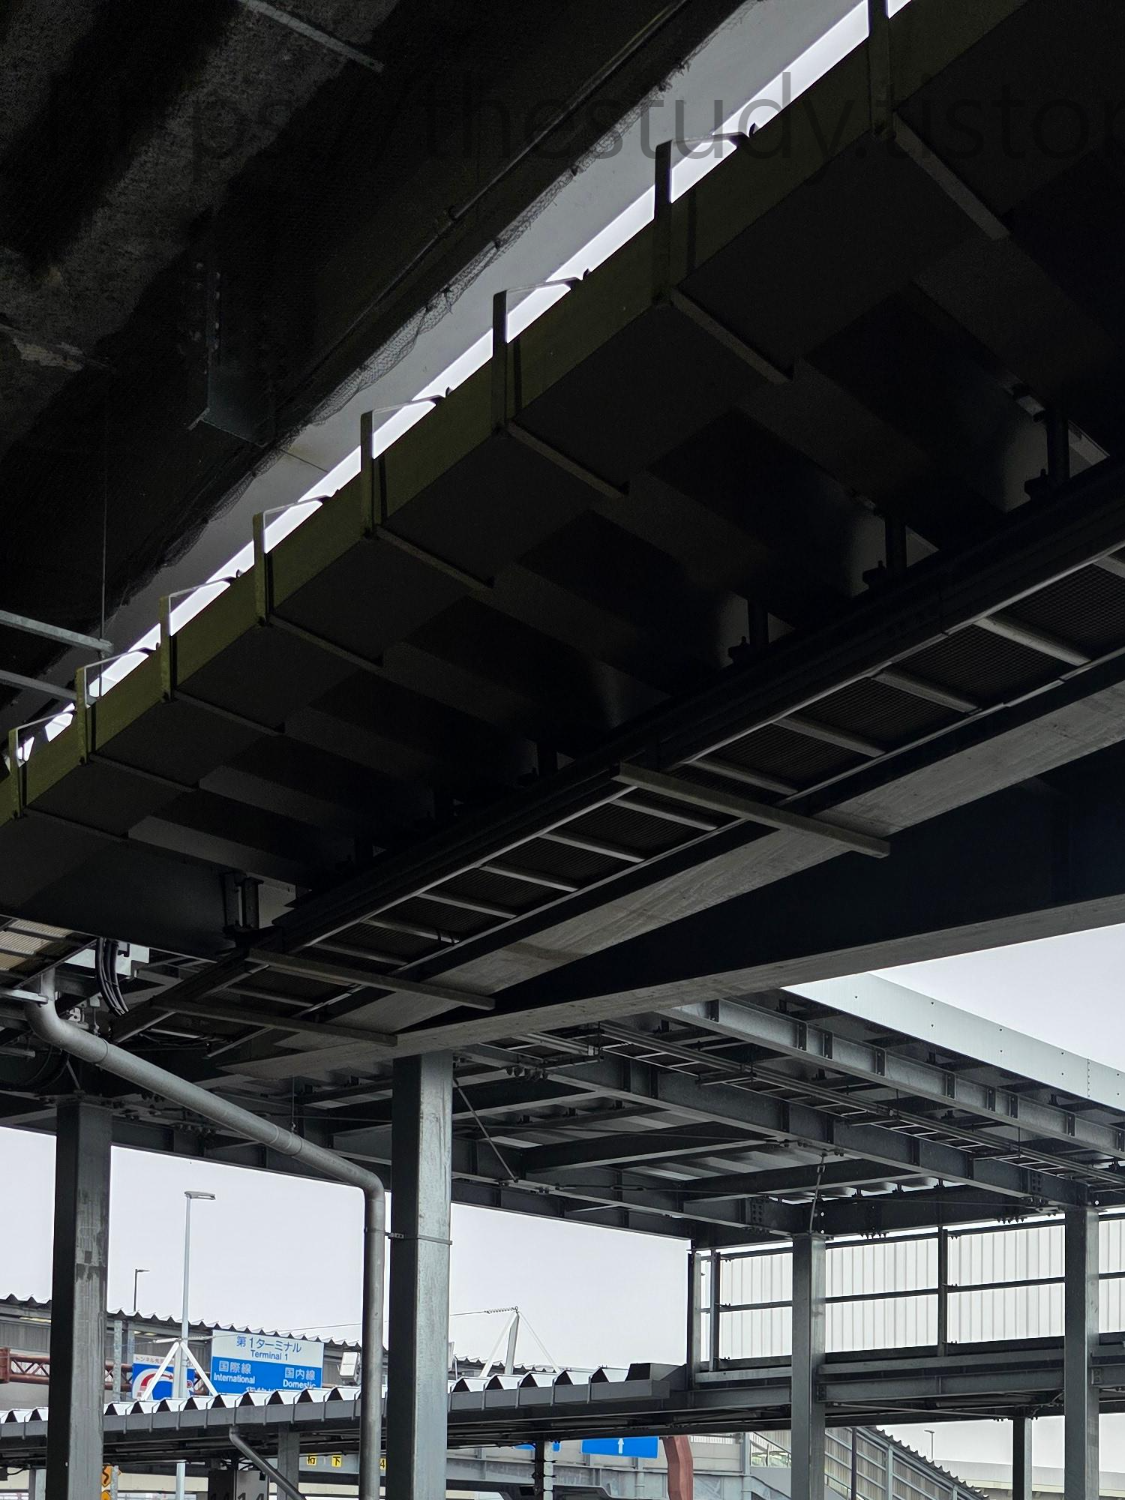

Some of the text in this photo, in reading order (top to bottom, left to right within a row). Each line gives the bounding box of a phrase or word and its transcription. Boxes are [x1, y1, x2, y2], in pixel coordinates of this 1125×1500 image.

[236, 1335, 302, 1353] 第1ターミナル
[251, 1349, 283, 1361] Terminal
[218, 1360, 252, 1374] 国際線
[213, 1372, 256, 1384] International
[284, 1367, 316, 1381] 国内線
[283, 1378, 317, 1389] Domestic
